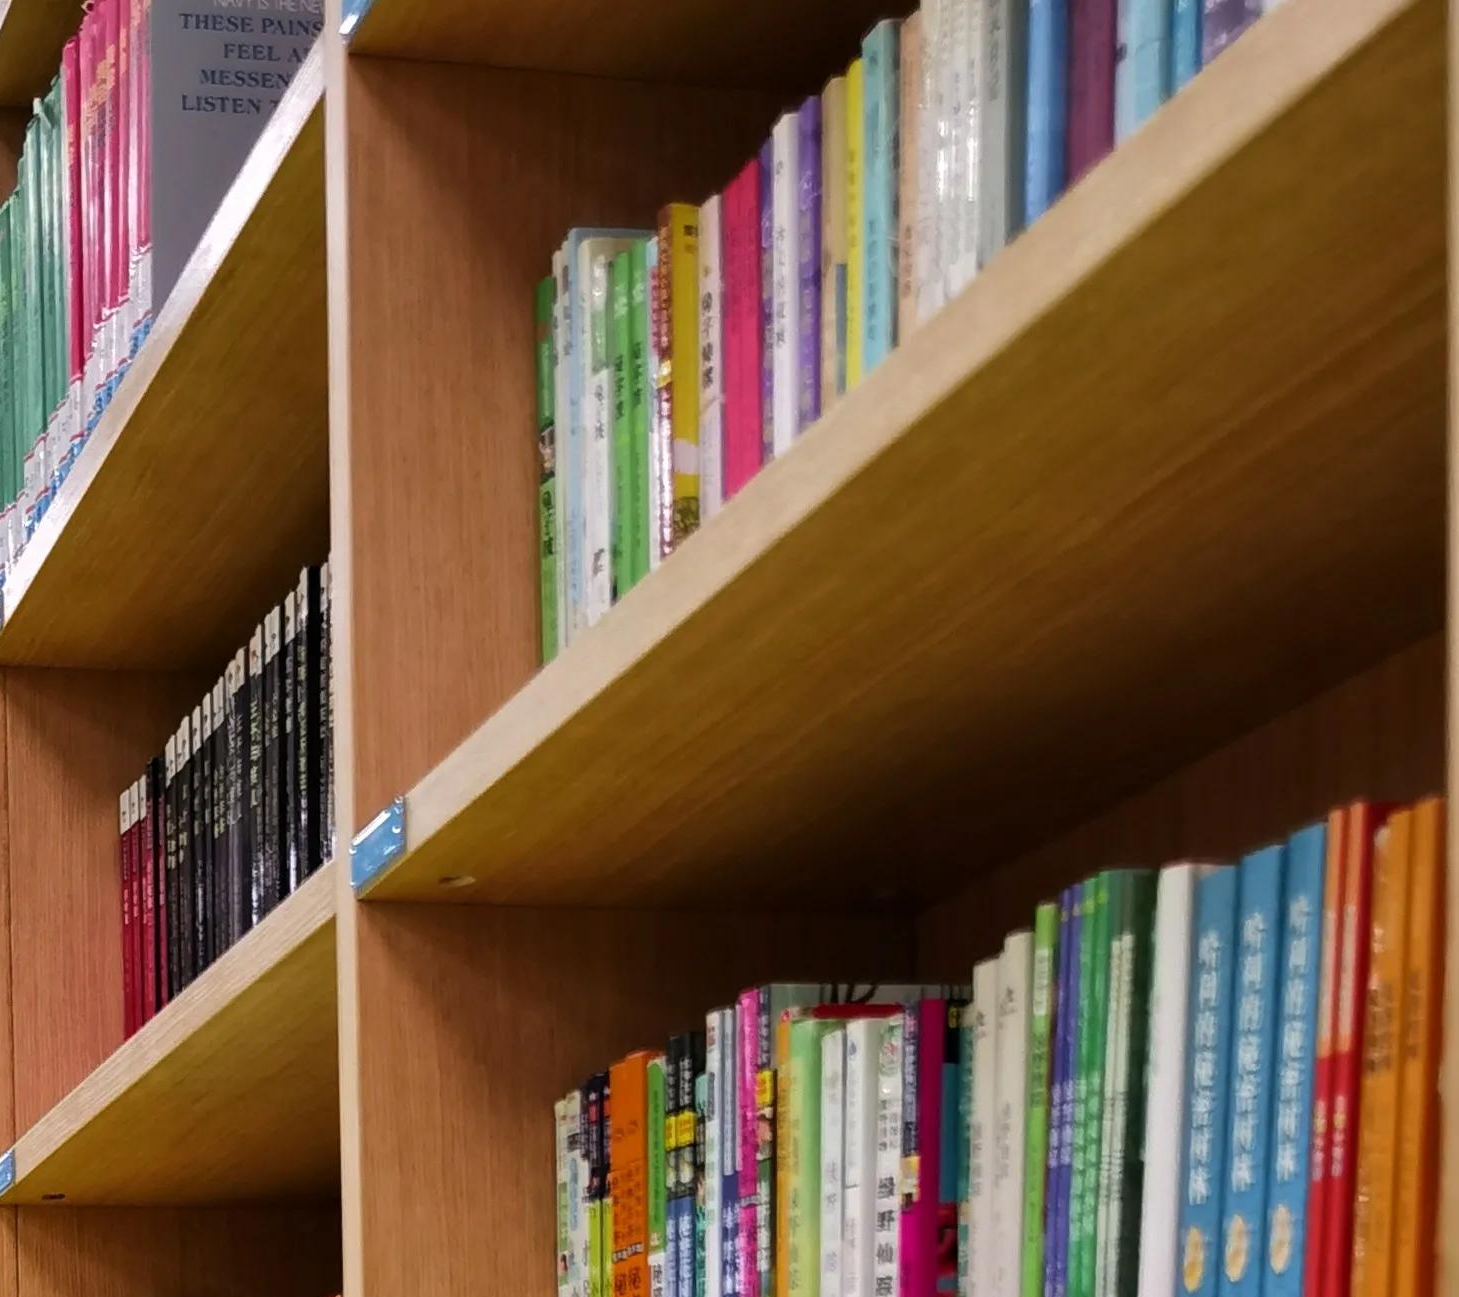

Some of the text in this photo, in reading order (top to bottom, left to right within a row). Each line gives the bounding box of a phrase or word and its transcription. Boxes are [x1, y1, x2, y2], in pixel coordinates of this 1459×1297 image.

[182, 14, 254, 34] THESE
[223, 44, 281, 62] FEEL
[182, 95, 261, 116] LISTEN
